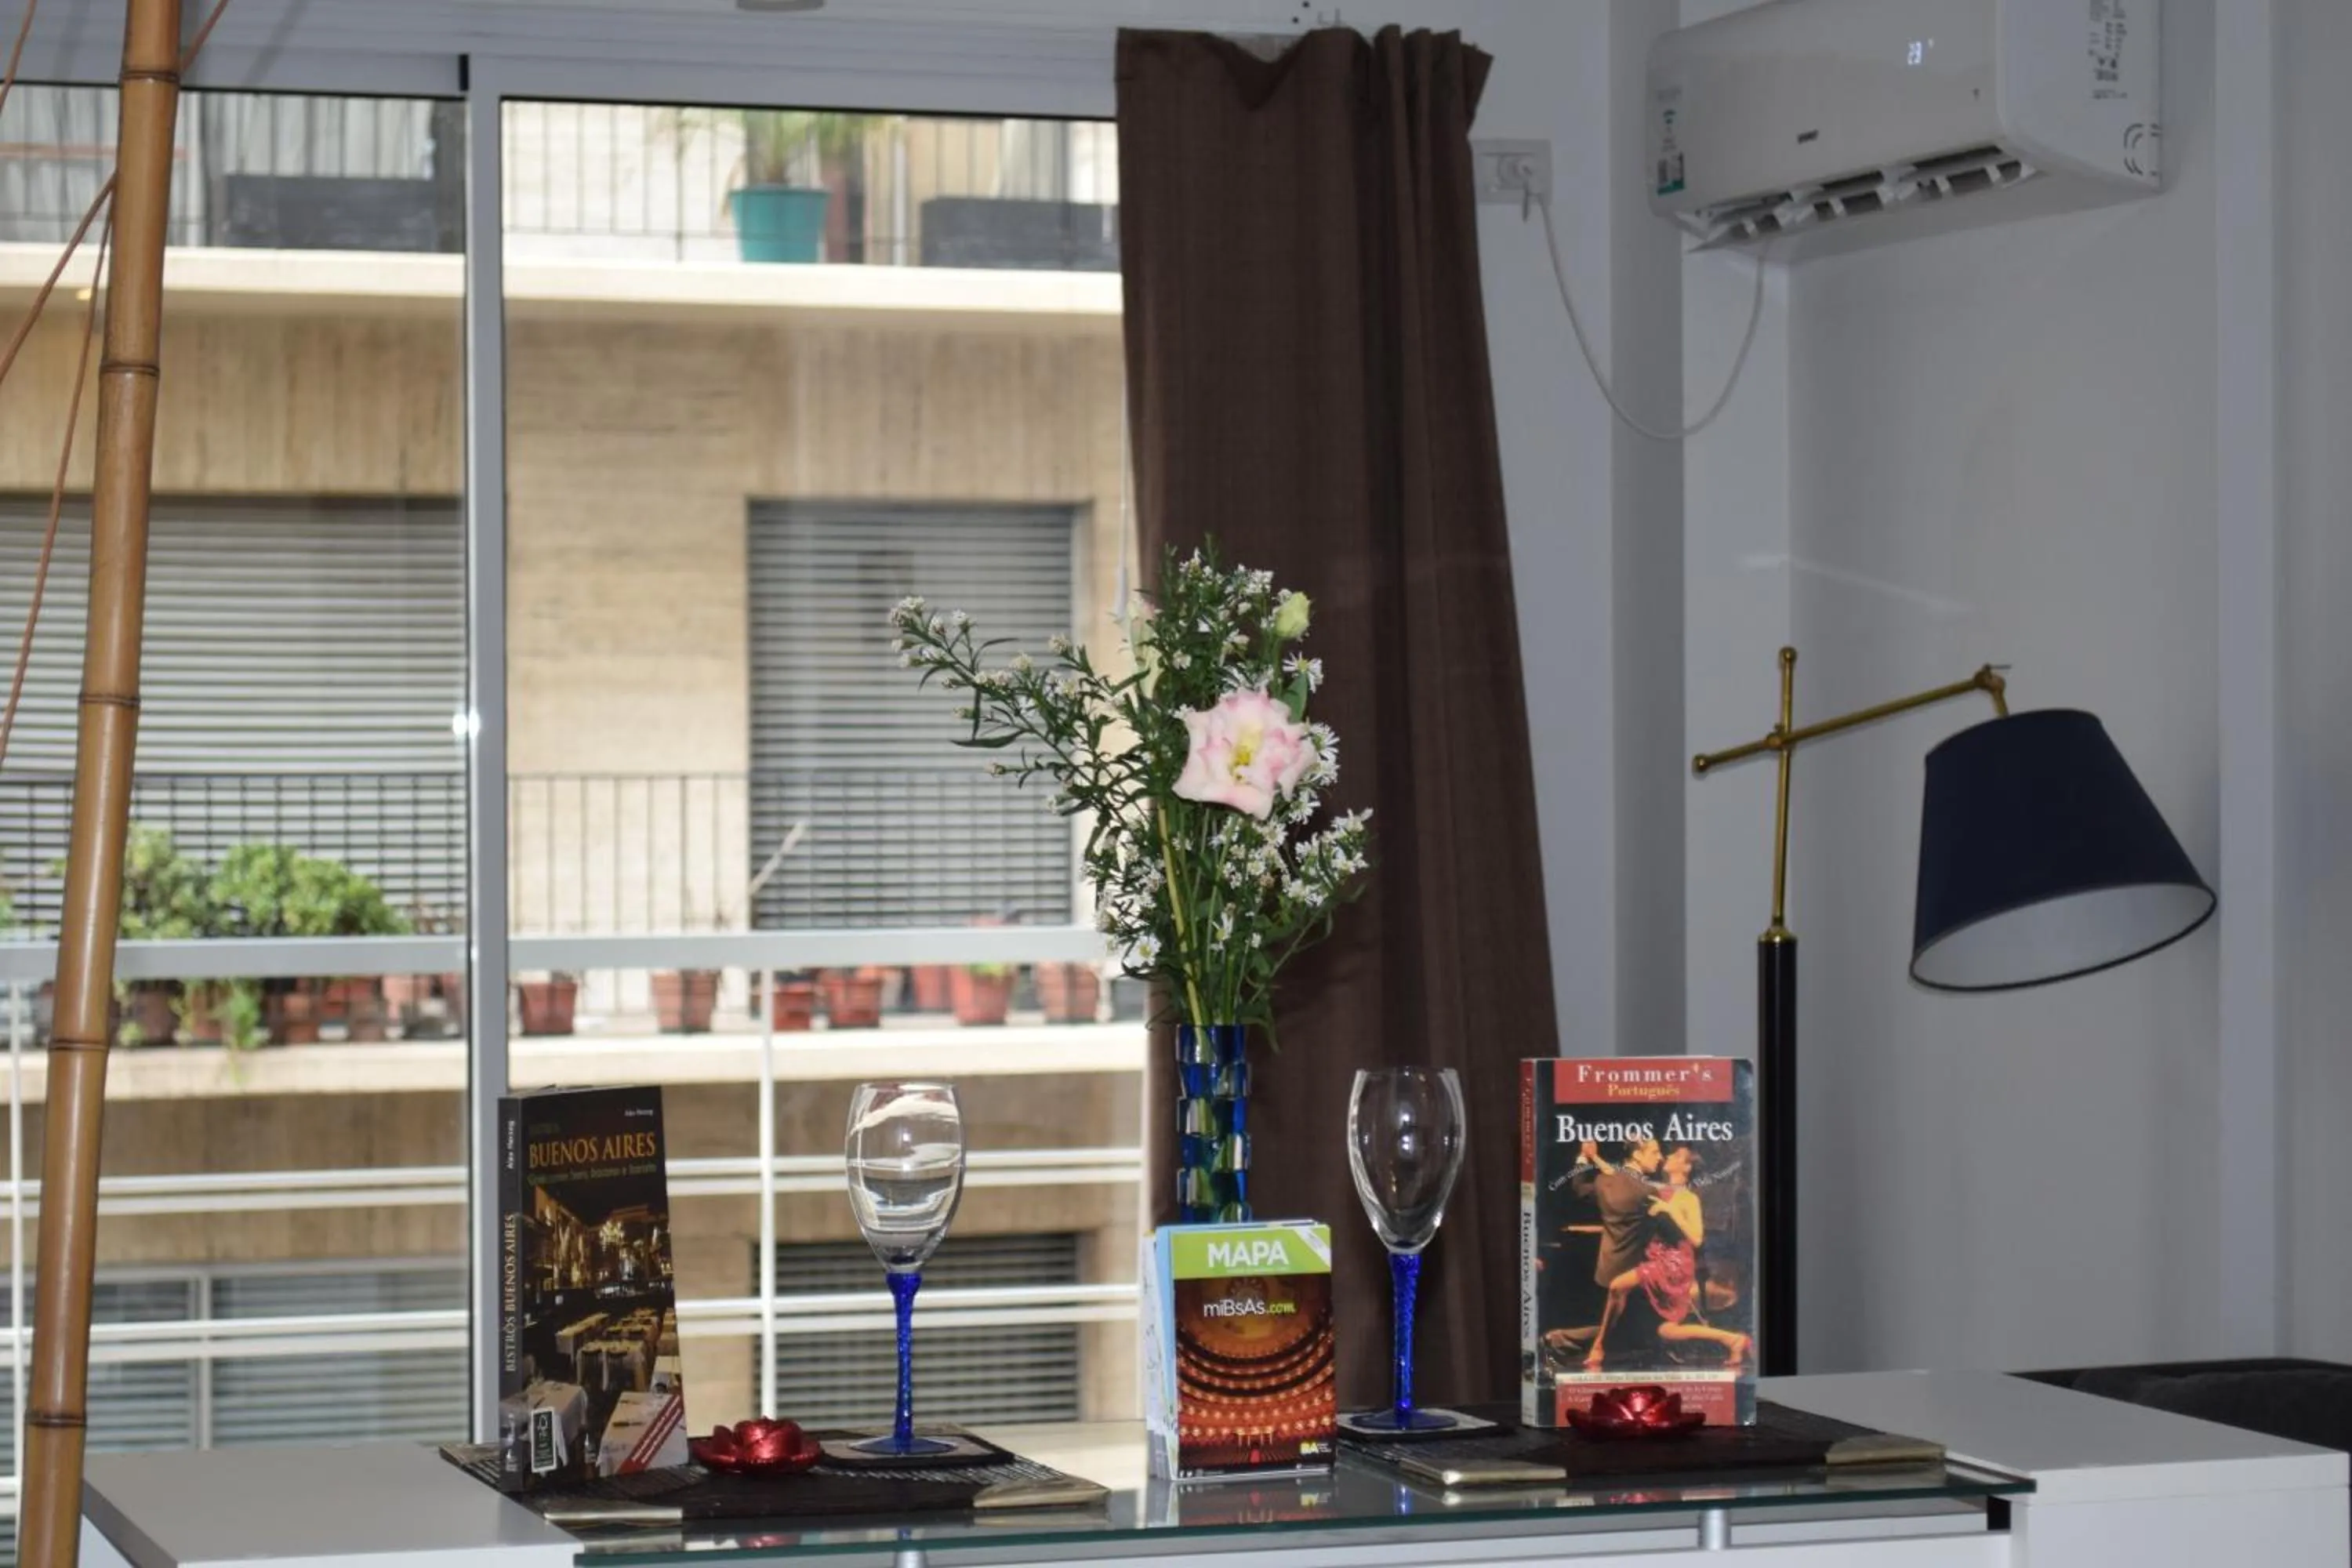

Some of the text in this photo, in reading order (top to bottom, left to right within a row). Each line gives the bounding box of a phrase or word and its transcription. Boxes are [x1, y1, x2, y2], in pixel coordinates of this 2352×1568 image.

[1577, 1062, 1713, 1083] Frommer's
[1607, 1084, 1680, 1099] Português
[1555, 1112, 1733, 1142] Buenos Aires
[529, 1132, 656, 1168] BUENOS AIRES
[503, 1214, 515, 1252] AIRES
[1207, 1240, 1289, 1269] MAPA
[503, 1255, 516, 1312] BUENOS
